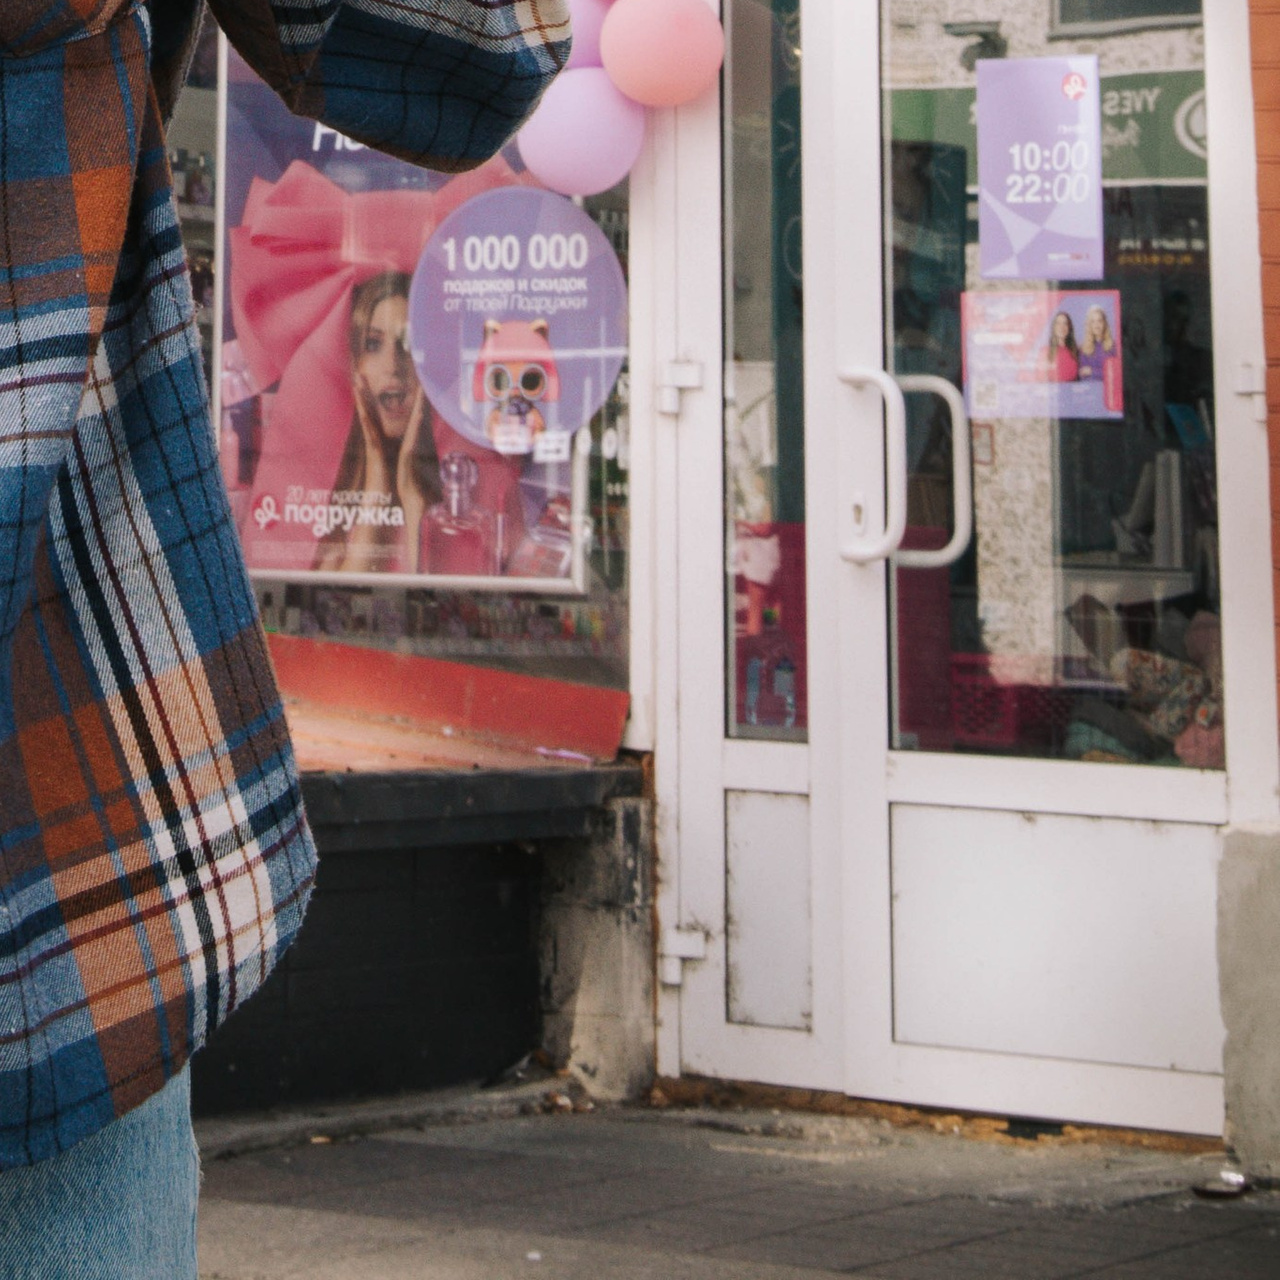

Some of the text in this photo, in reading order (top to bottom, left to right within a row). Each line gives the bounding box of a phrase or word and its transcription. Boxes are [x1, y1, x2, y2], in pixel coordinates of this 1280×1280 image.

[1009, 140, 1089, 171] 10:00
[1006, 173, 1089, 203] 22:00
[531, 277, 588, 293] скидок
[284, 503, 405, 538] подружка
